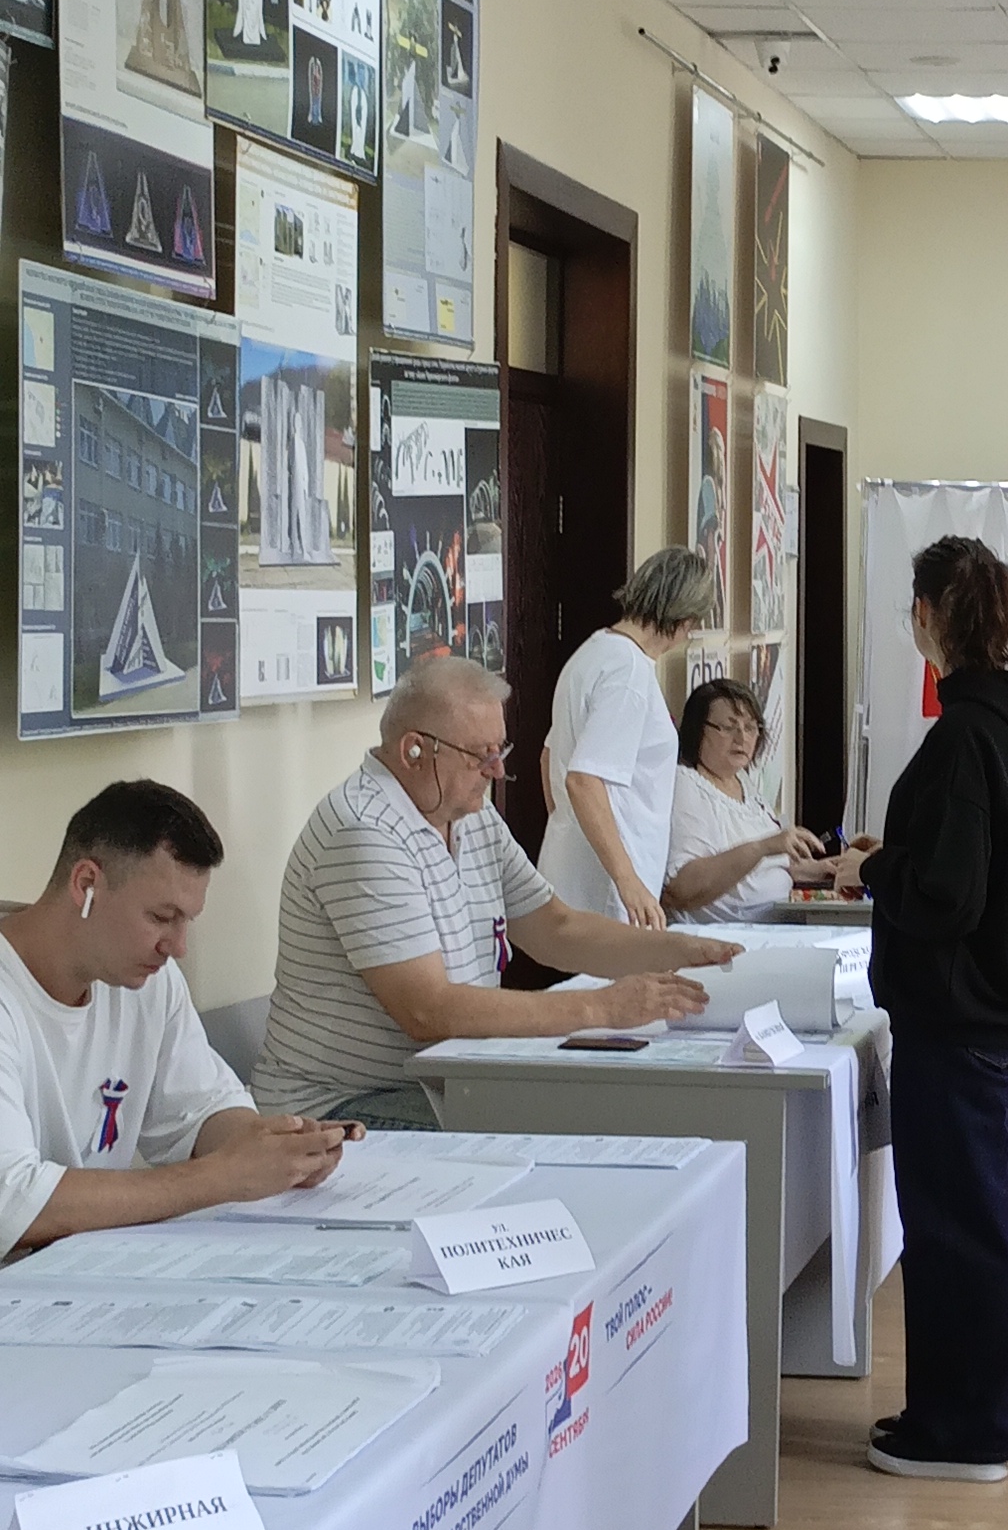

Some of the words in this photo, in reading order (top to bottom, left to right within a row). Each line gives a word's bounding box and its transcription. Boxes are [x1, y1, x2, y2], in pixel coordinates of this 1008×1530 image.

[440, 1227, 572, 1259] ПОЛИТЕХНИЧЕС
[497, 1253, 532, 1270] КАЯ
[569, 1325, 588, 1379] 20
[460, 1423, 517, 1503] ДЕПУТАТОВ
[505, 1451, 529, 1495] ДУМЫ
